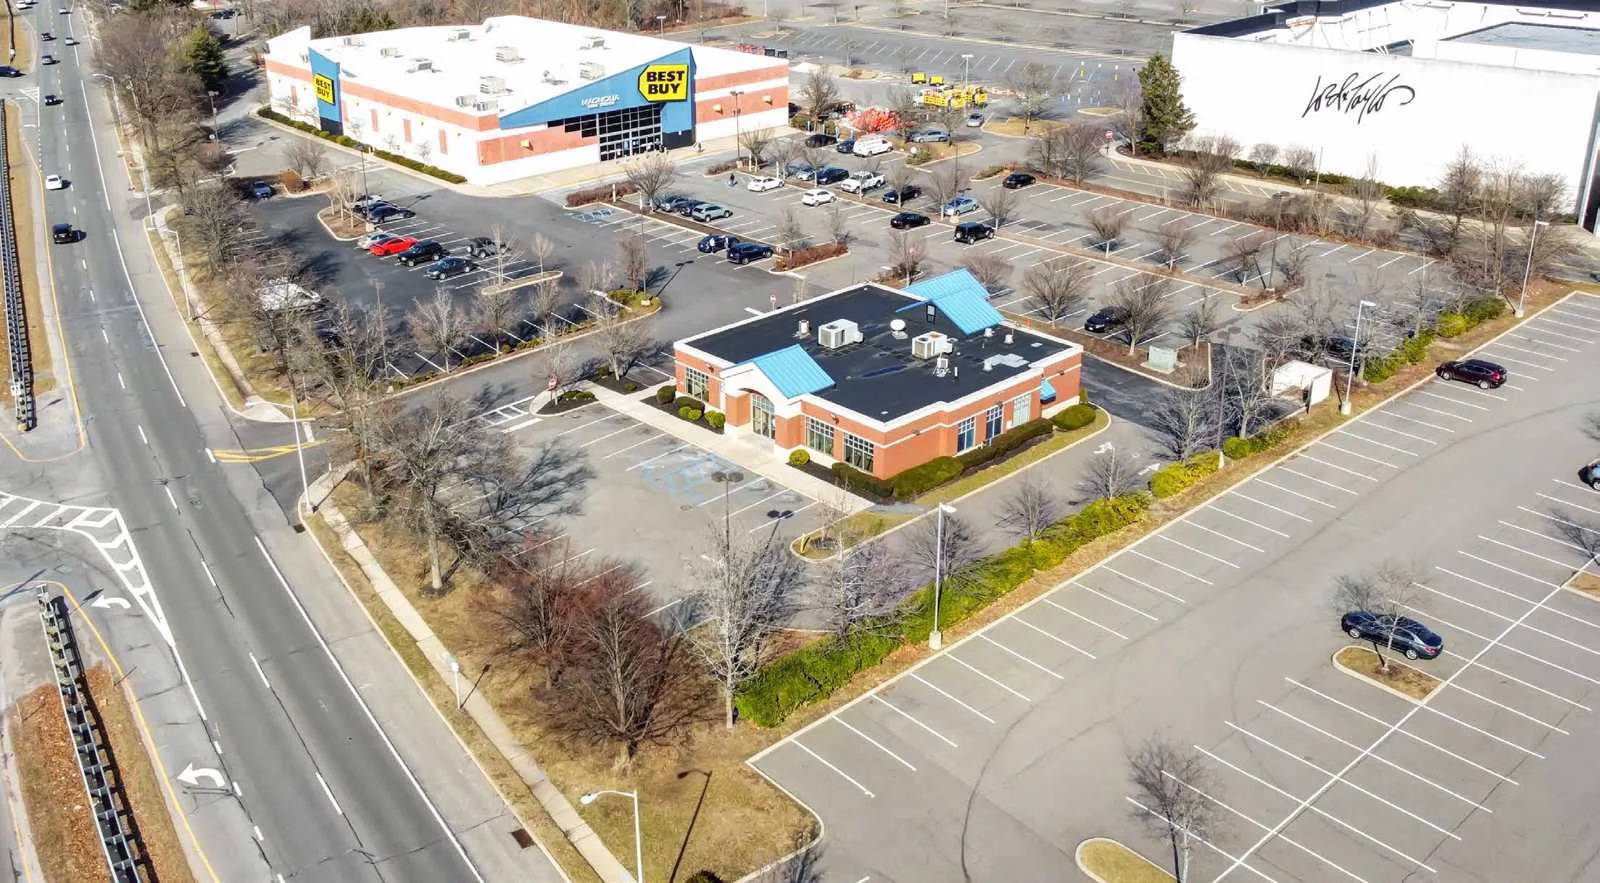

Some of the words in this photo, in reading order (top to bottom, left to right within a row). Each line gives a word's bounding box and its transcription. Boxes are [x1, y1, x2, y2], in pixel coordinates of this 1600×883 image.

[646, 71, 685, 82] BEST
[316, 77, 330, 91] BEST
[648, 83, 681, 94] BUY
[317, 87, 330, 98] BUY
